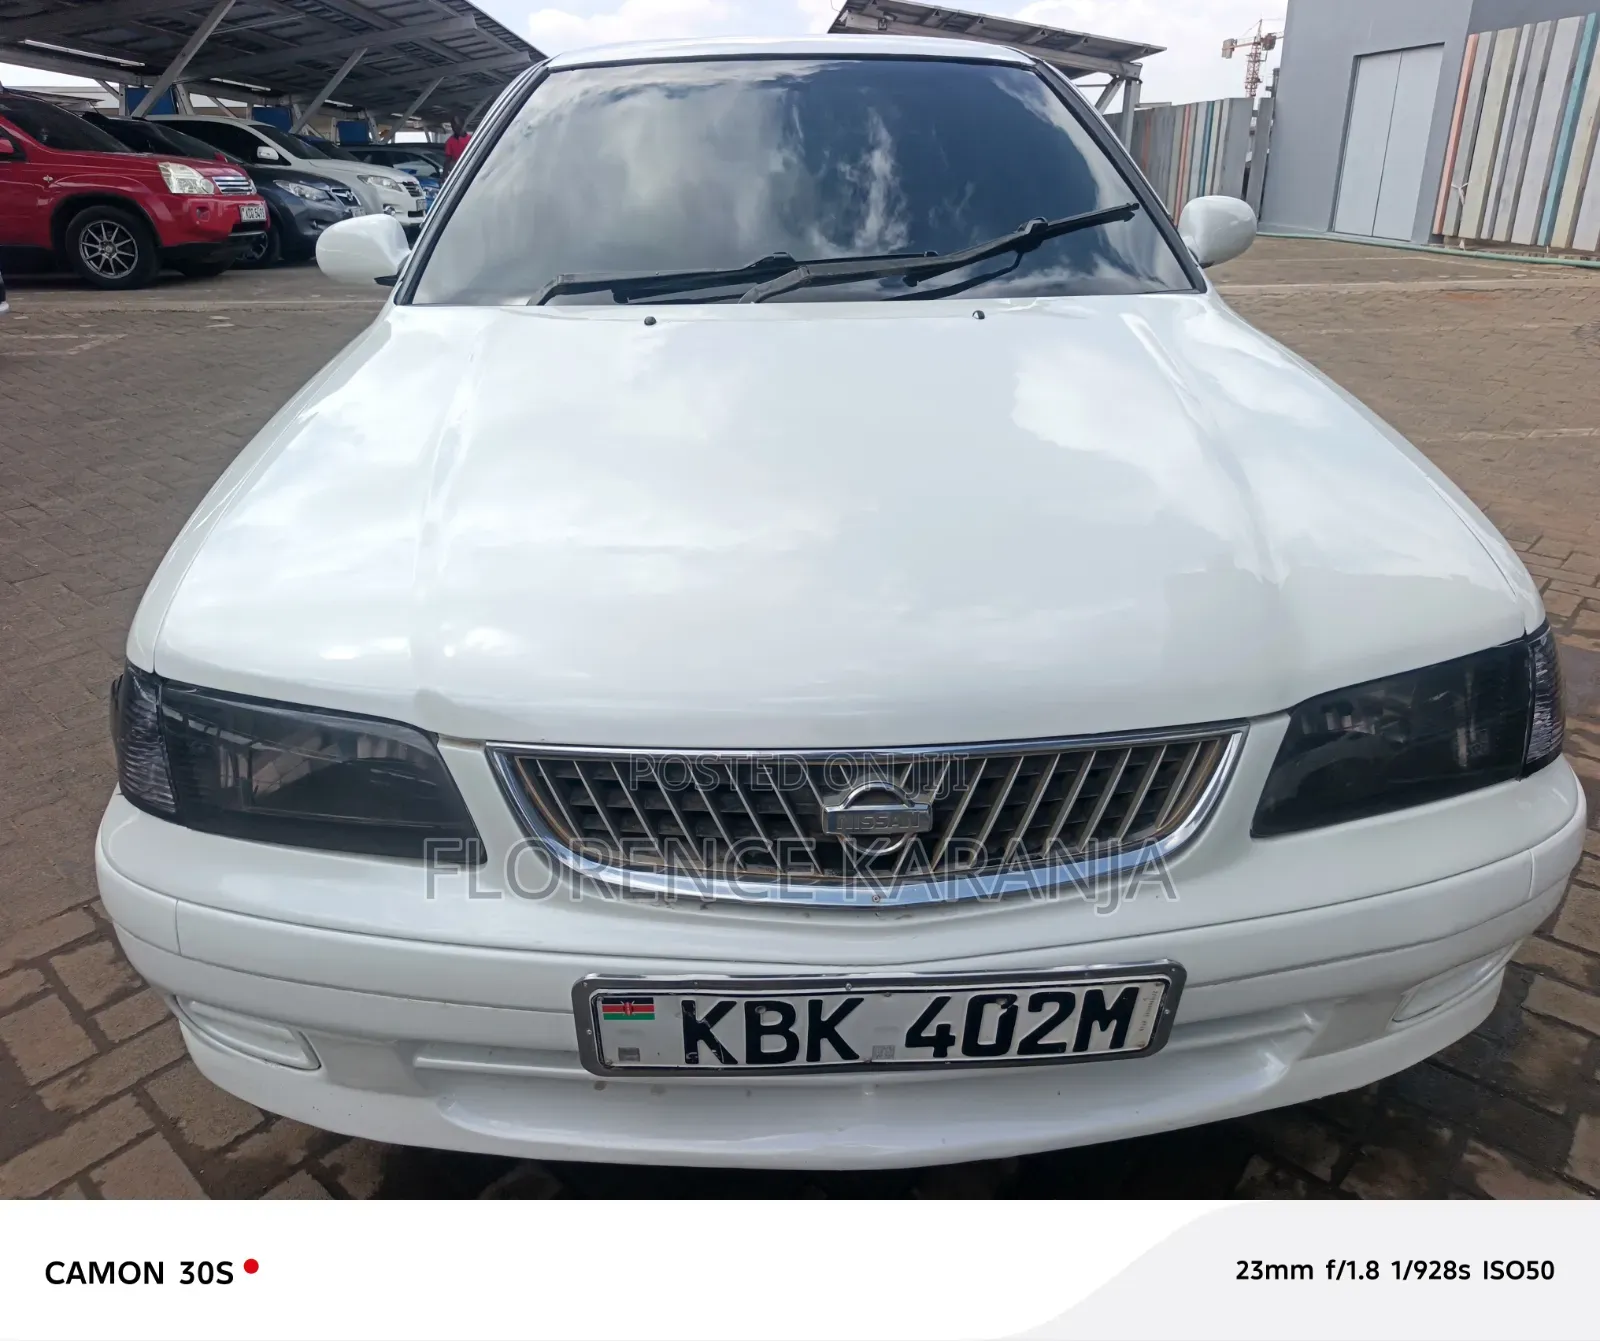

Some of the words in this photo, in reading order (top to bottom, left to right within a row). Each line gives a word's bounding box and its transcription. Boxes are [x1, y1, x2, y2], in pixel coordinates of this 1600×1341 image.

[836, 810, 920, 830] NISSAN
[681, 997, 864, 1065] KBK
[904, 987, 1140, 1059] 402M
